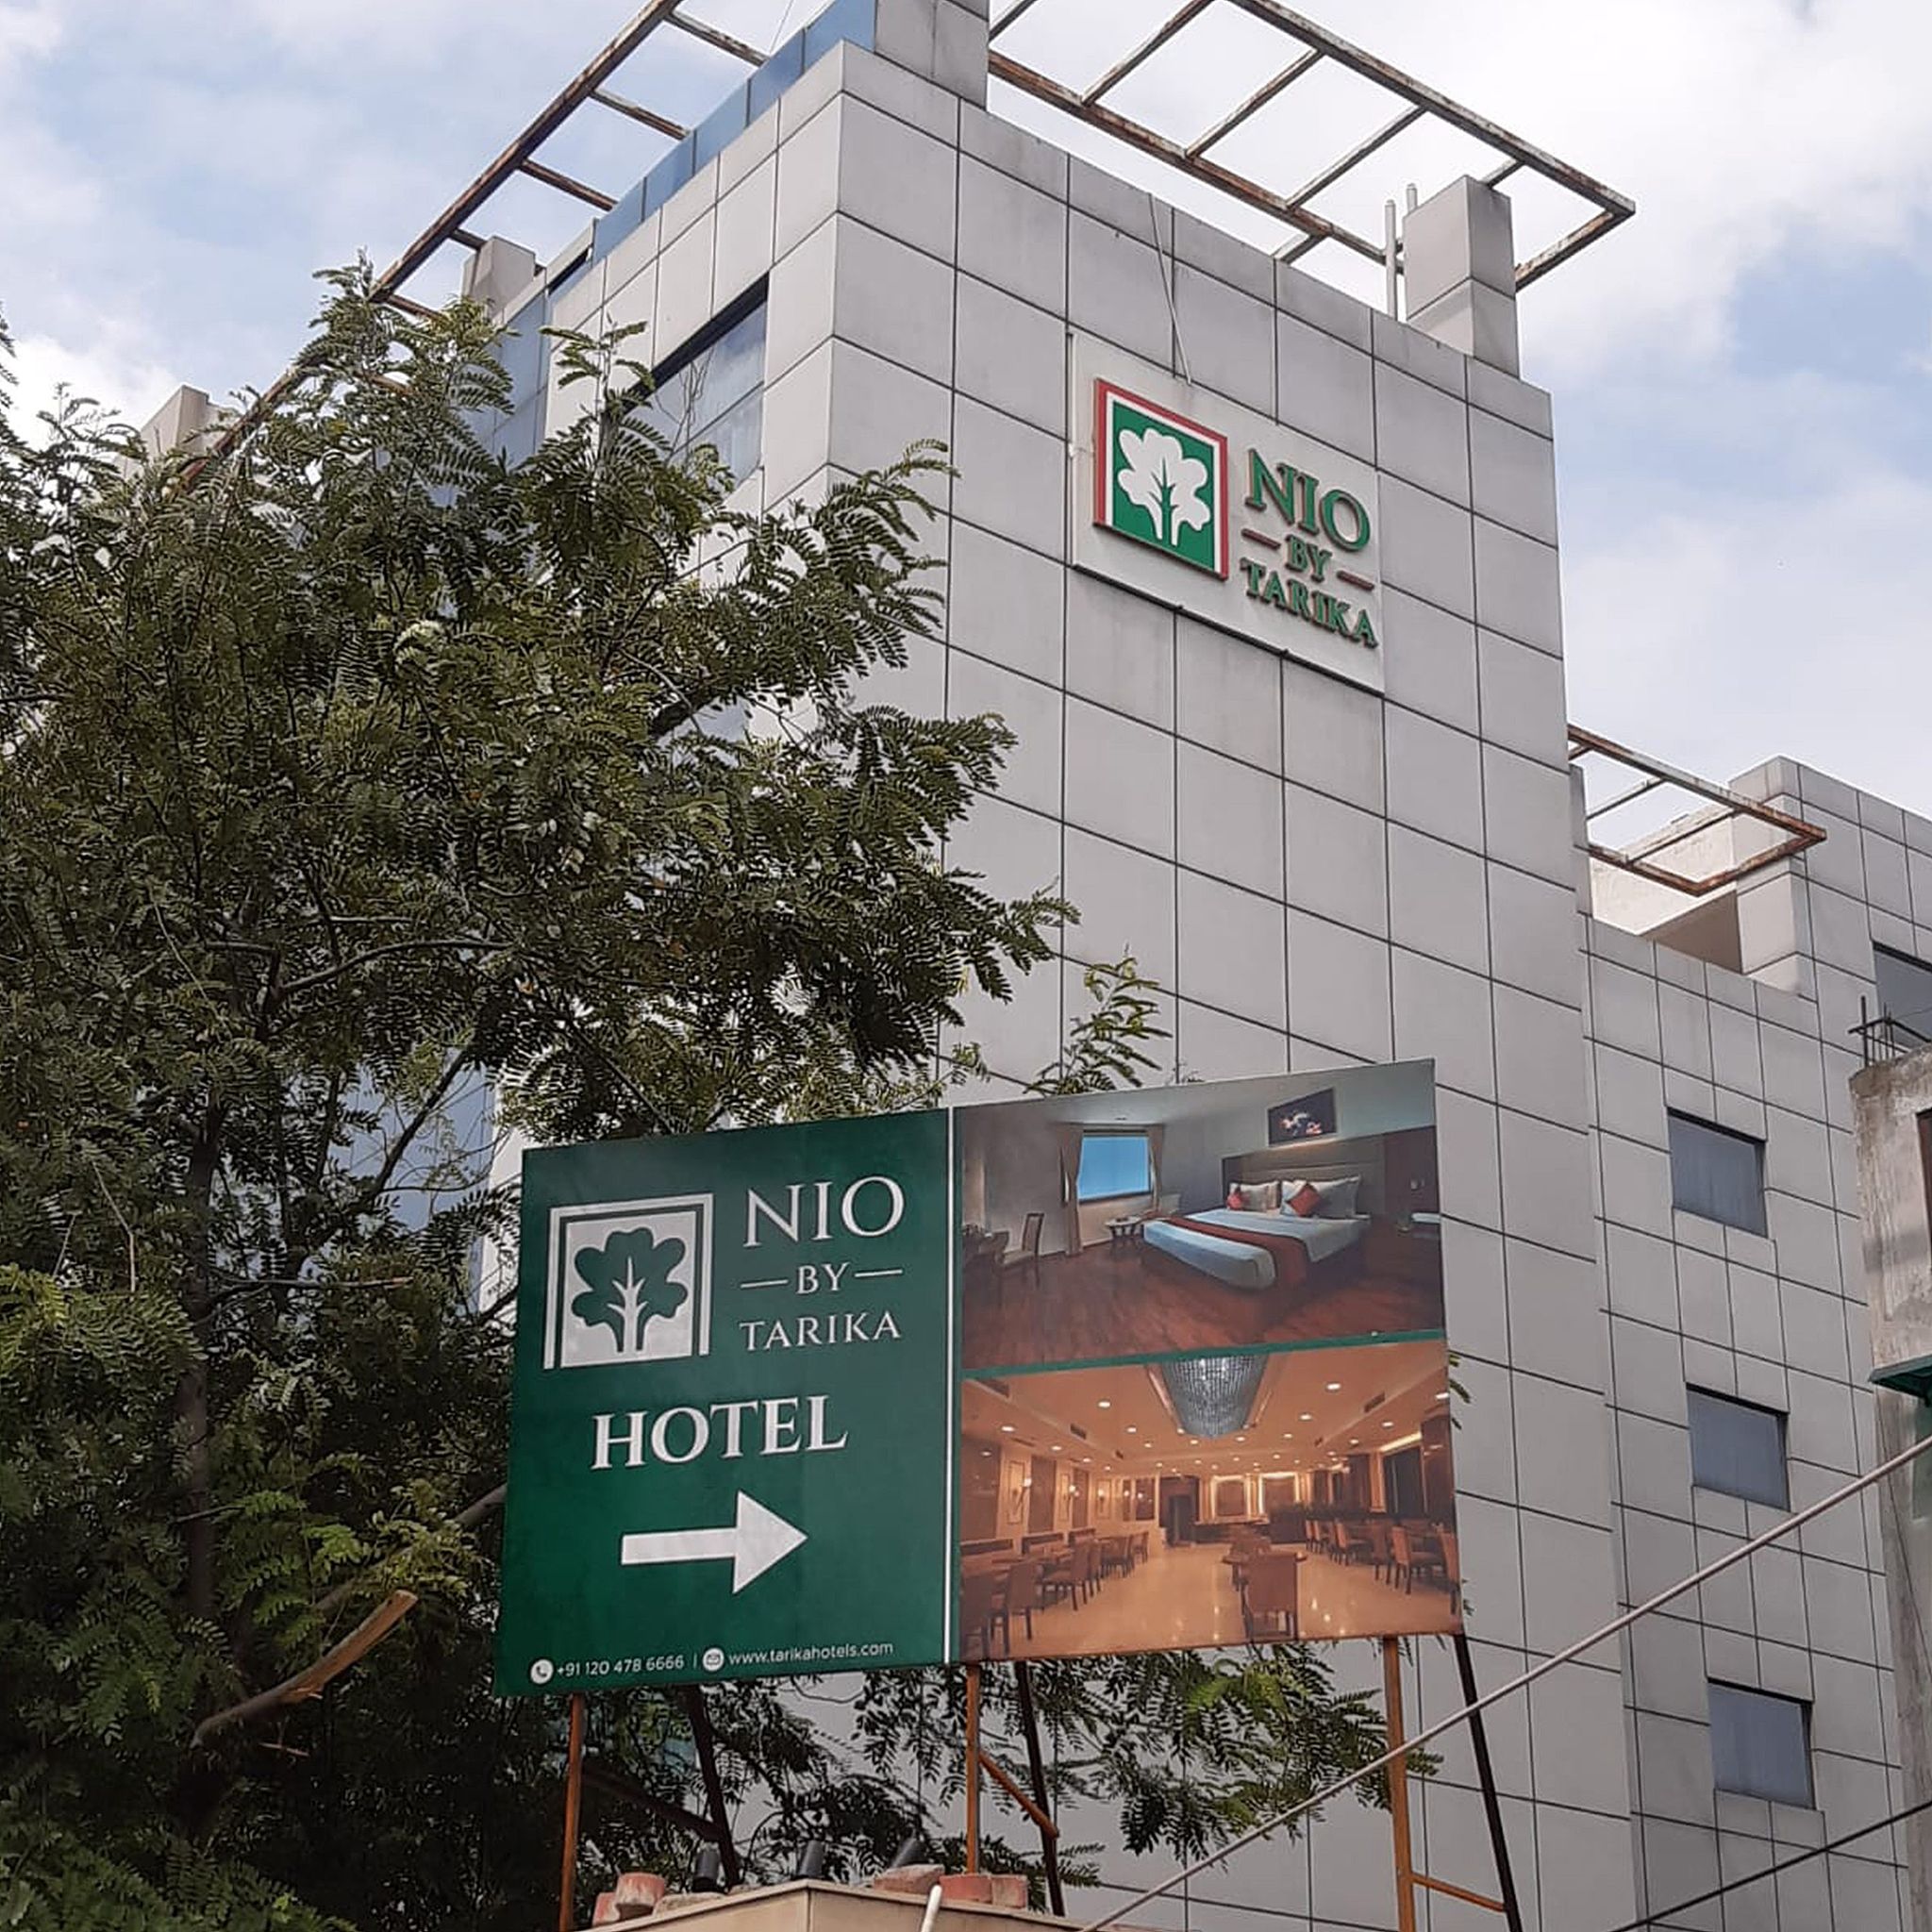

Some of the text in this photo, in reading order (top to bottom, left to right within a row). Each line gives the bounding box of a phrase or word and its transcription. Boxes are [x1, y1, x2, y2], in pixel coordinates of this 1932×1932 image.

[1244, 448, 1371, 553] NIO
[1285, 534, 1333, 583] BY
[1240, 557, 1379, 649] TARIKA
[742, 1175, 906, 1248] NIO
[795, 1262, 850, 1295] BY
[740, 1311, 902, 1353] TARIKA
[590, 1394, 849, 1471] HOTEL
[557, 1655, 685, 1677] +91 120 478 6666
[728, 1641, 894, 1666] www.tarikahotels.com
